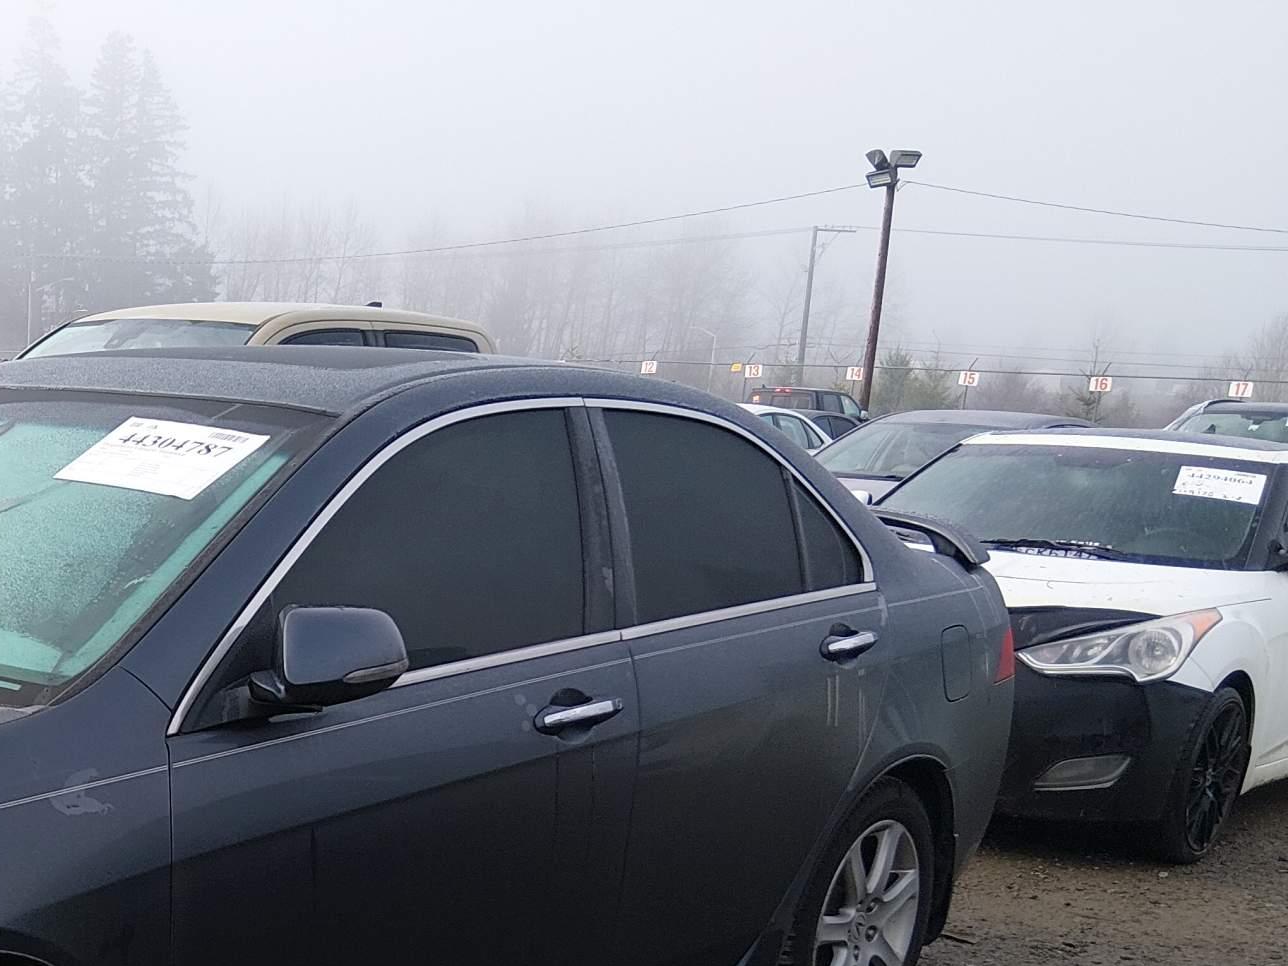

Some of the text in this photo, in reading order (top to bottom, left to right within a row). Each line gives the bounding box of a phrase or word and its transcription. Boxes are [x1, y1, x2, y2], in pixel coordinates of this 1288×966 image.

[644, 362, 655, 373] 12
[748, 365, 760, 377] 13
[850, 368, 862, 379] 14
[962, 372, 976, 384] 15
[1093, 378, 1108, 390] 16
[1235, 383, 1250, 395] 17
[119, 433, 232, 457] 44304787
